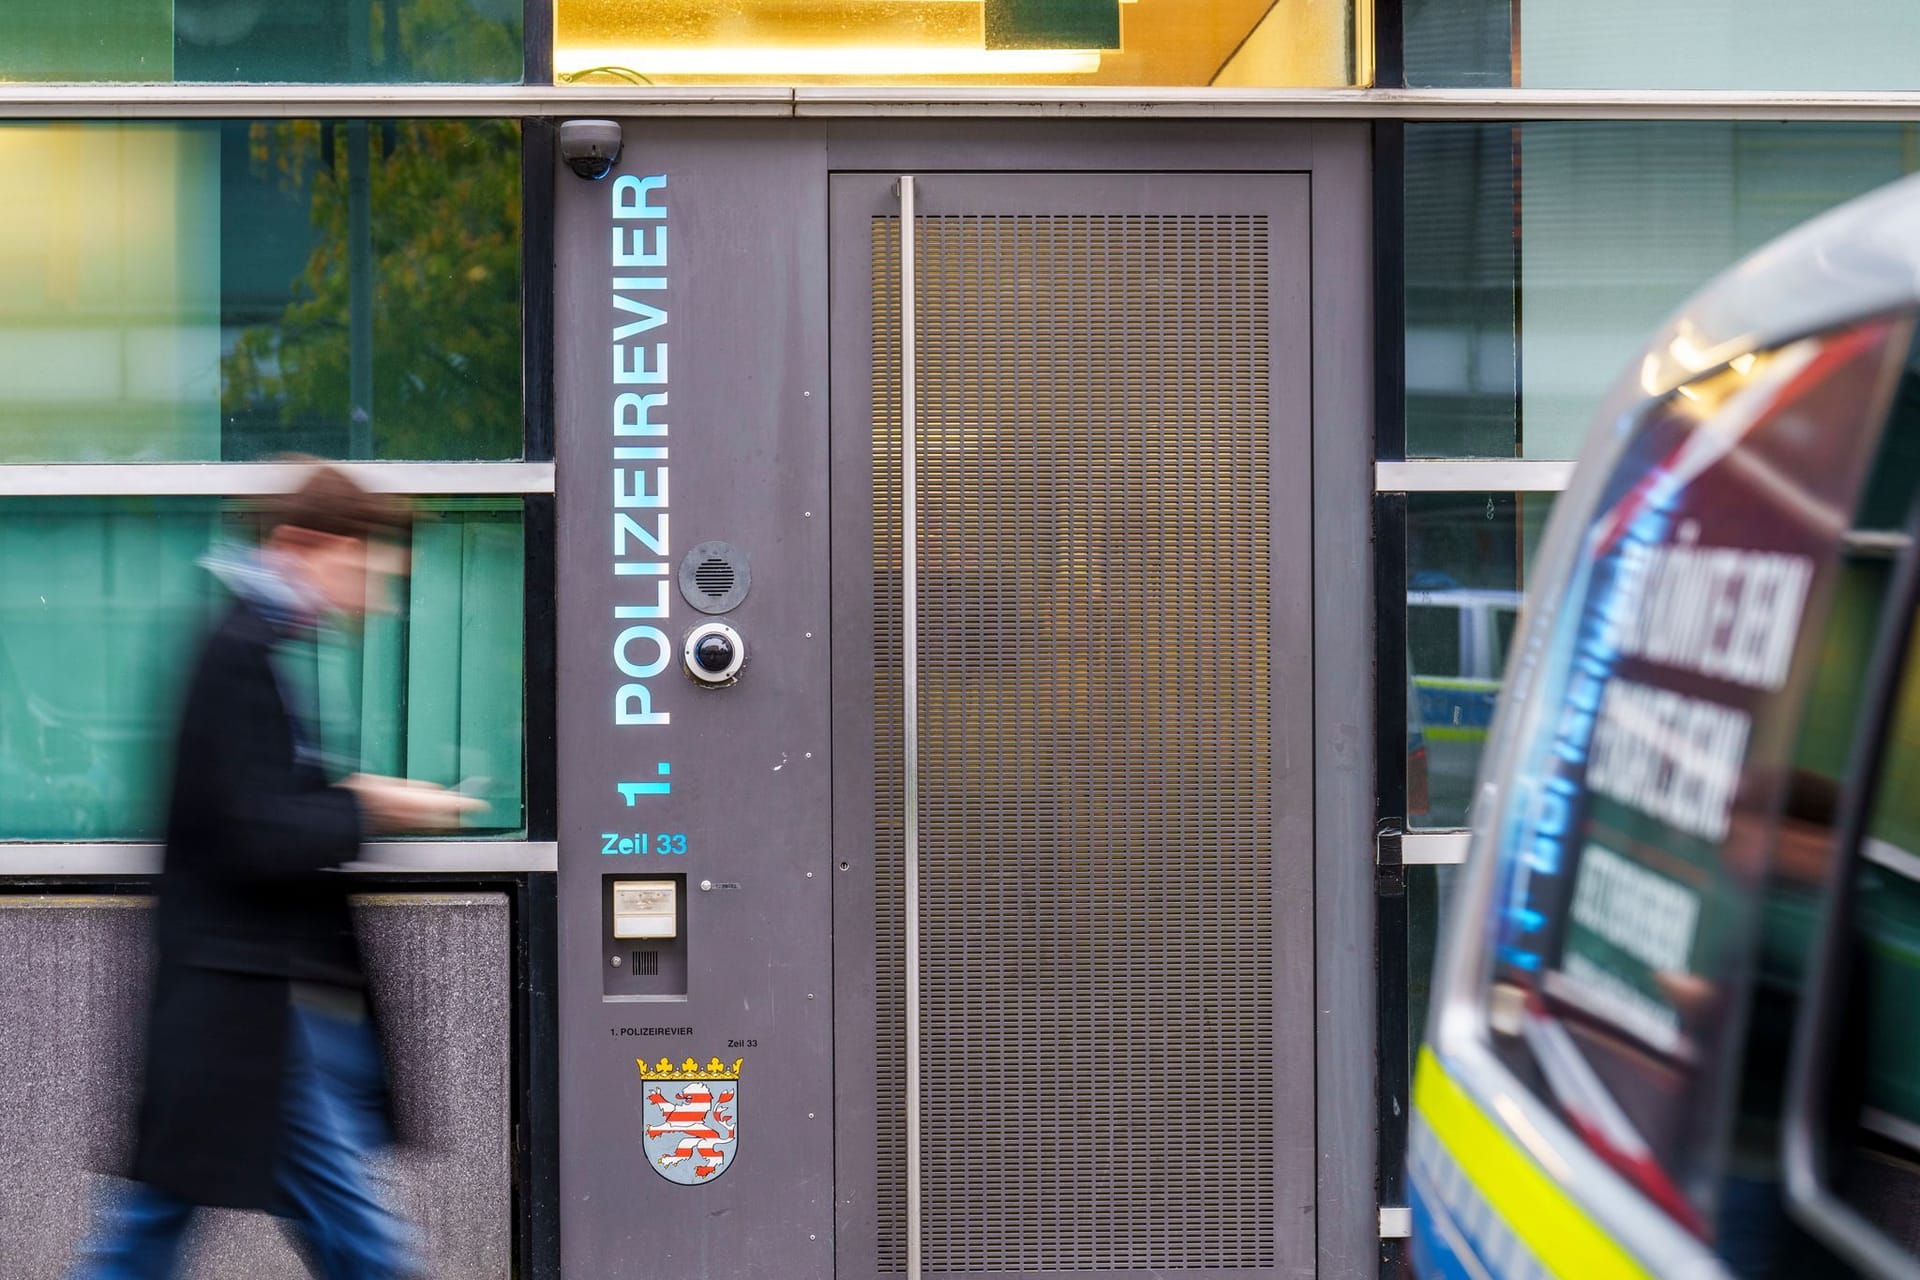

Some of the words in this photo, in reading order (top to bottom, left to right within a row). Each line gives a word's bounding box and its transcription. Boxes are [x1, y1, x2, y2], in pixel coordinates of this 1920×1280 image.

[612, 173, 671, 726] POLIZEIREVIER
[616, 762, 671, 807] 1.
[601, 832, 648, 855] Zeil
[656, 833, 688, 855] 33
[610, 1028, 618, 1036] 1.
[620, 1027, 693, 1036] POLIZEIREVIER
[727, 1039, 745, 1048] Zeil
[747, 1039, 758, 1048] 33
